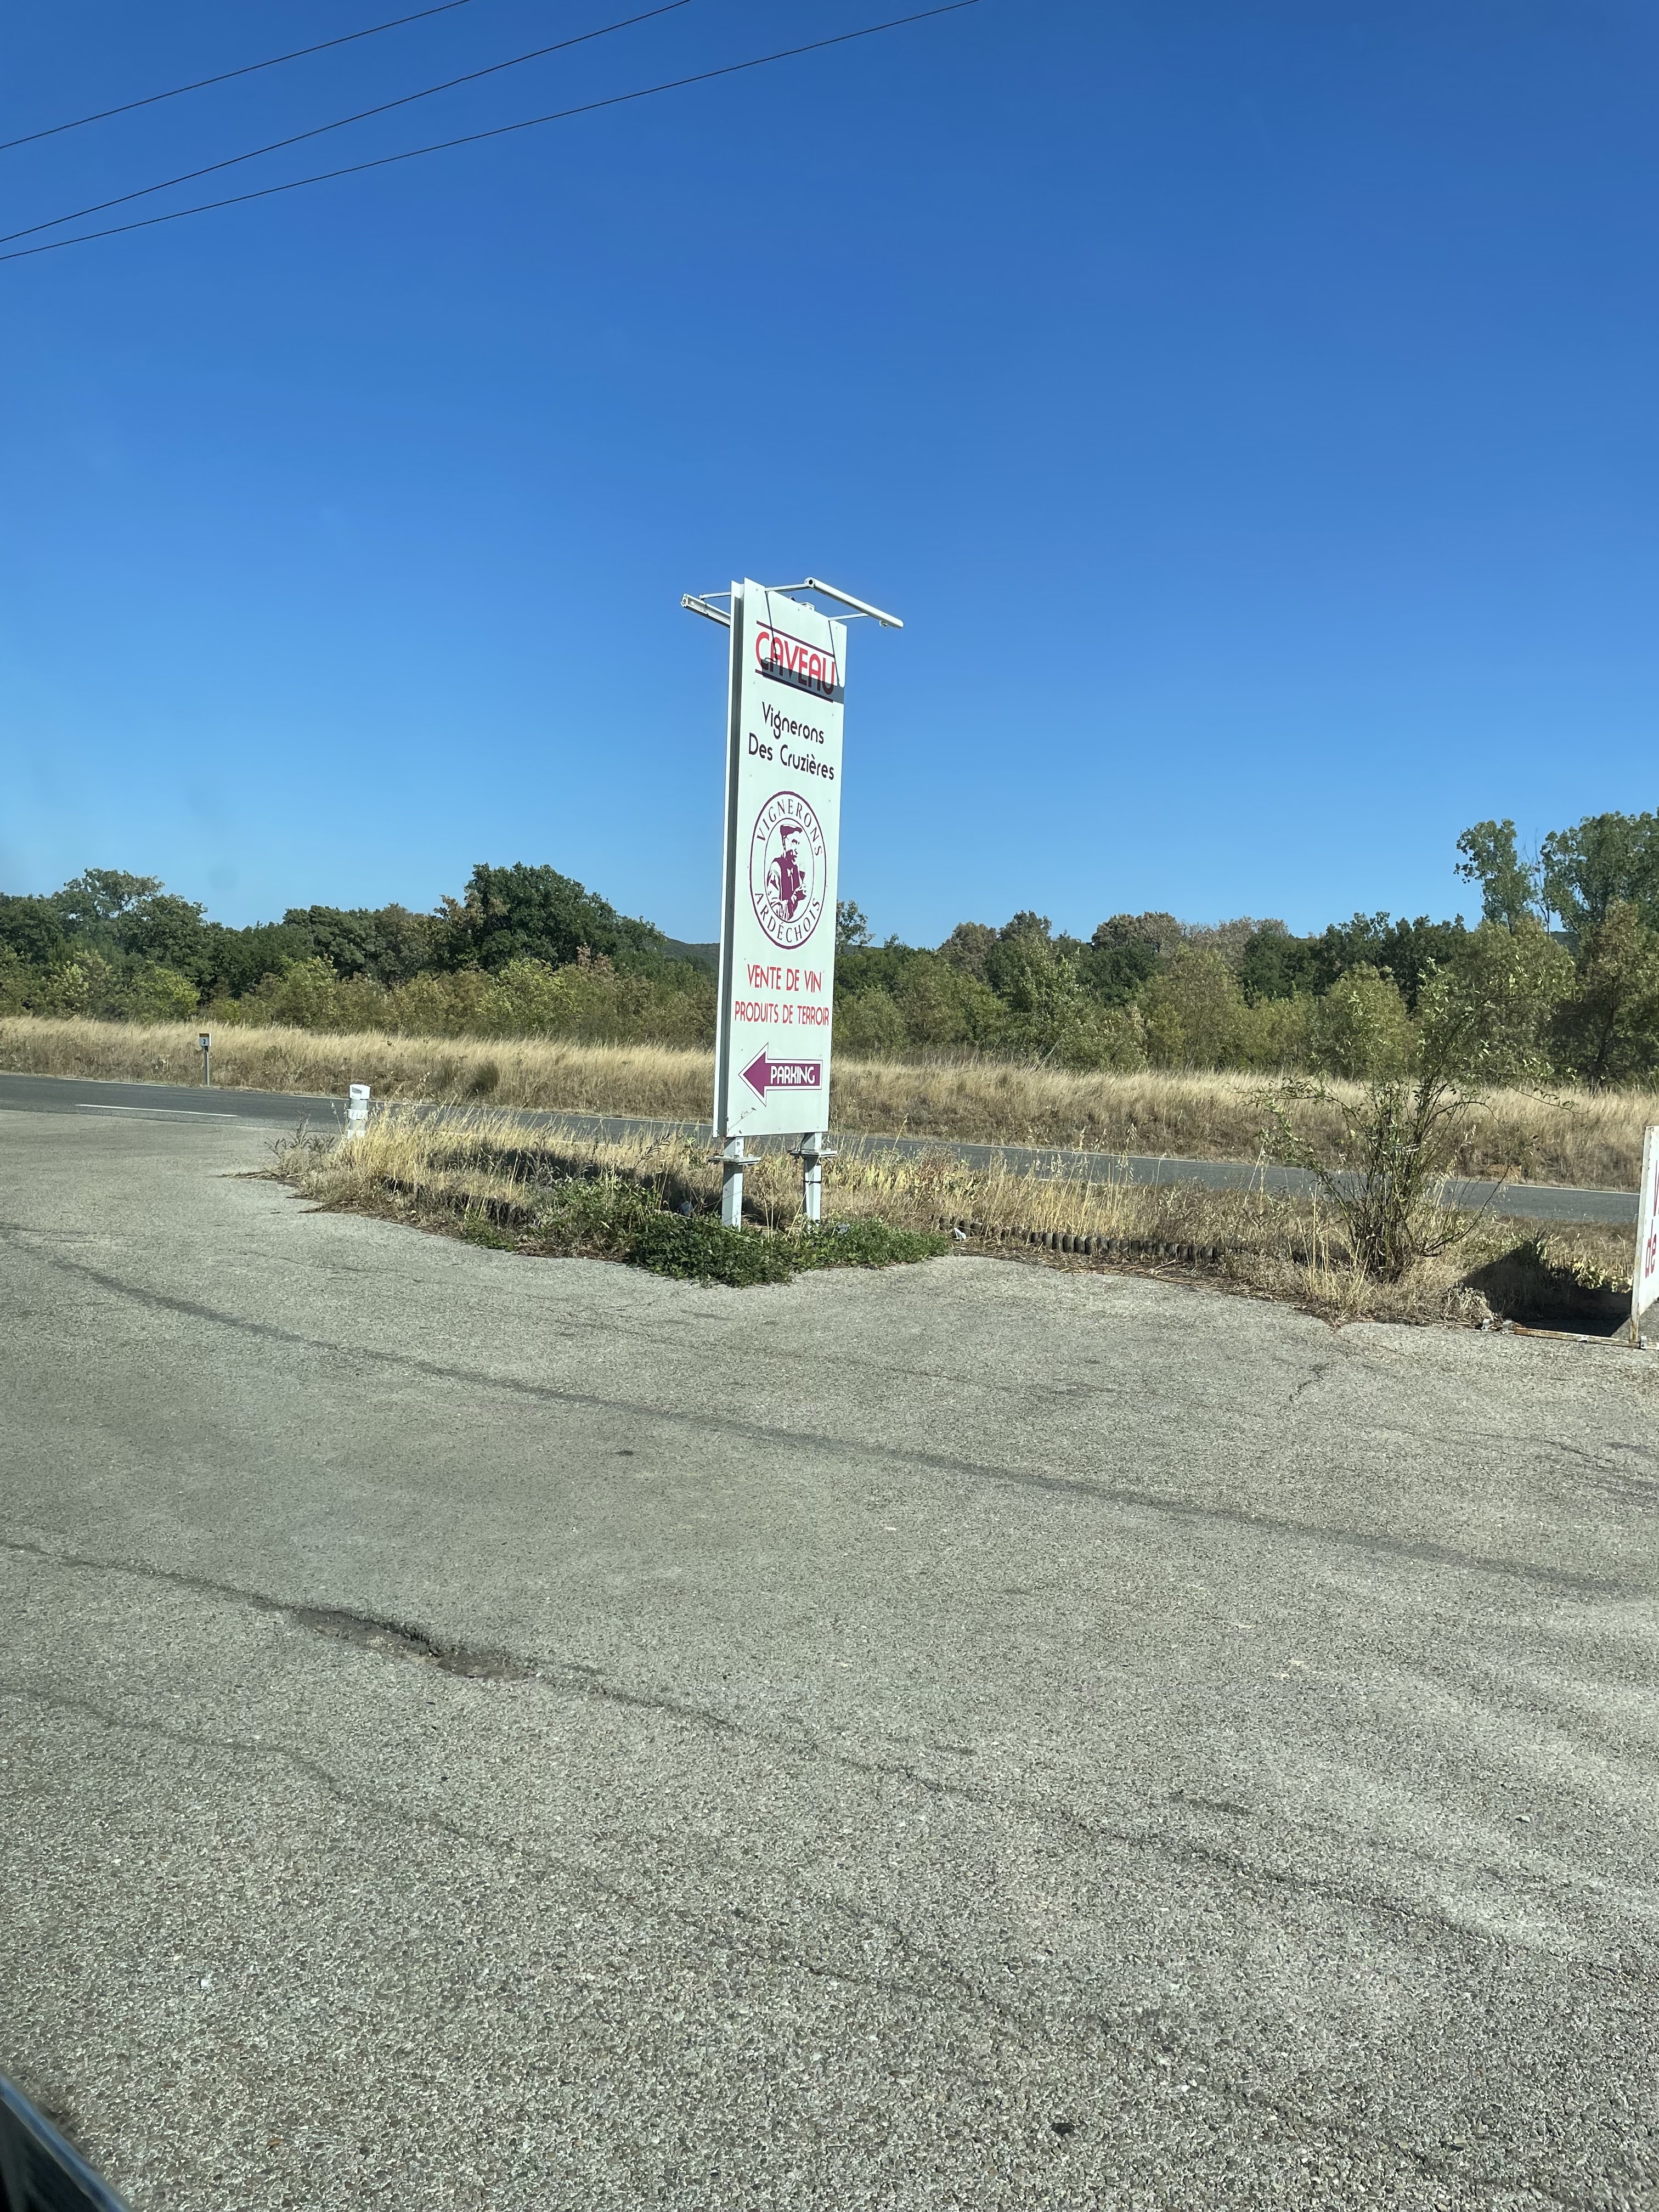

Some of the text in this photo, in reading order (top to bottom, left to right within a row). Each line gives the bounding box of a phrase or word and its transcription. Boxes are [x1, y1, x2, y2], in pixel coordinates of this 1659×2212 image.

[756, 631, 836, 695] CAVEAU
[762, 701, 824, 744] Vignerons
[749, 732, 834, 780] Des Cruzières
[757, 799, 822, 856] VIGNERONS
[755, 892, 820, 943] ARDÉCHOIS
[747, 964, 822, 993] VENTE DE VIN
[735, 1001, 829, 1026] PRODUITS DE TERROIR
[770, 1065, 815, 1085] PARKING
